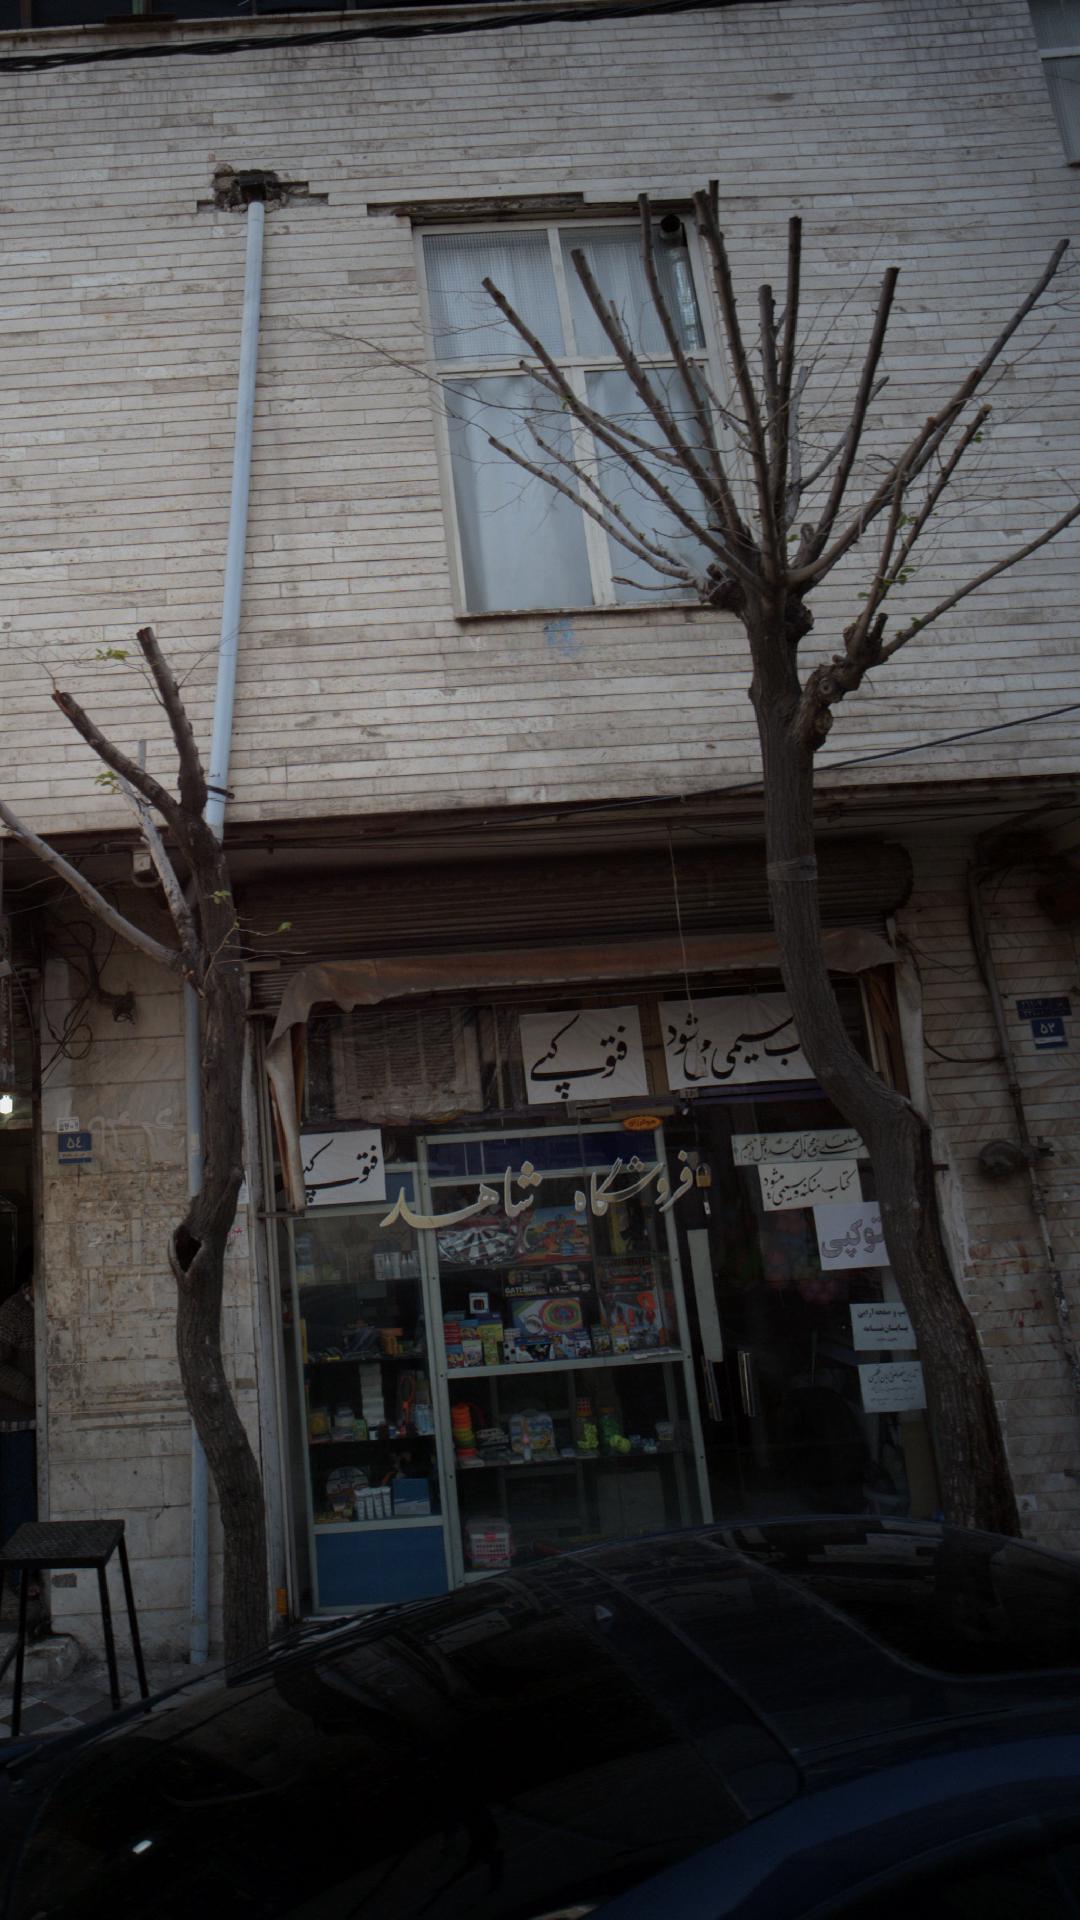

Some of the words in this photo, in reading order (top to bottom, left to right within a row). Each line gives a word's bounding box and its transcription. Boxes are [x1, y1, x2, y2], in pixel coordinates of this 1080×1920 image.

[530, 1013, 628, 1100] فتوکپی
[379, 1160, 543, 1229] شاهد
[574, 1150, 694, 1217] فروشگاه
[822, 1169, 857, 1199] کتاب
[822, 1216, 884, 1258] توکپی
